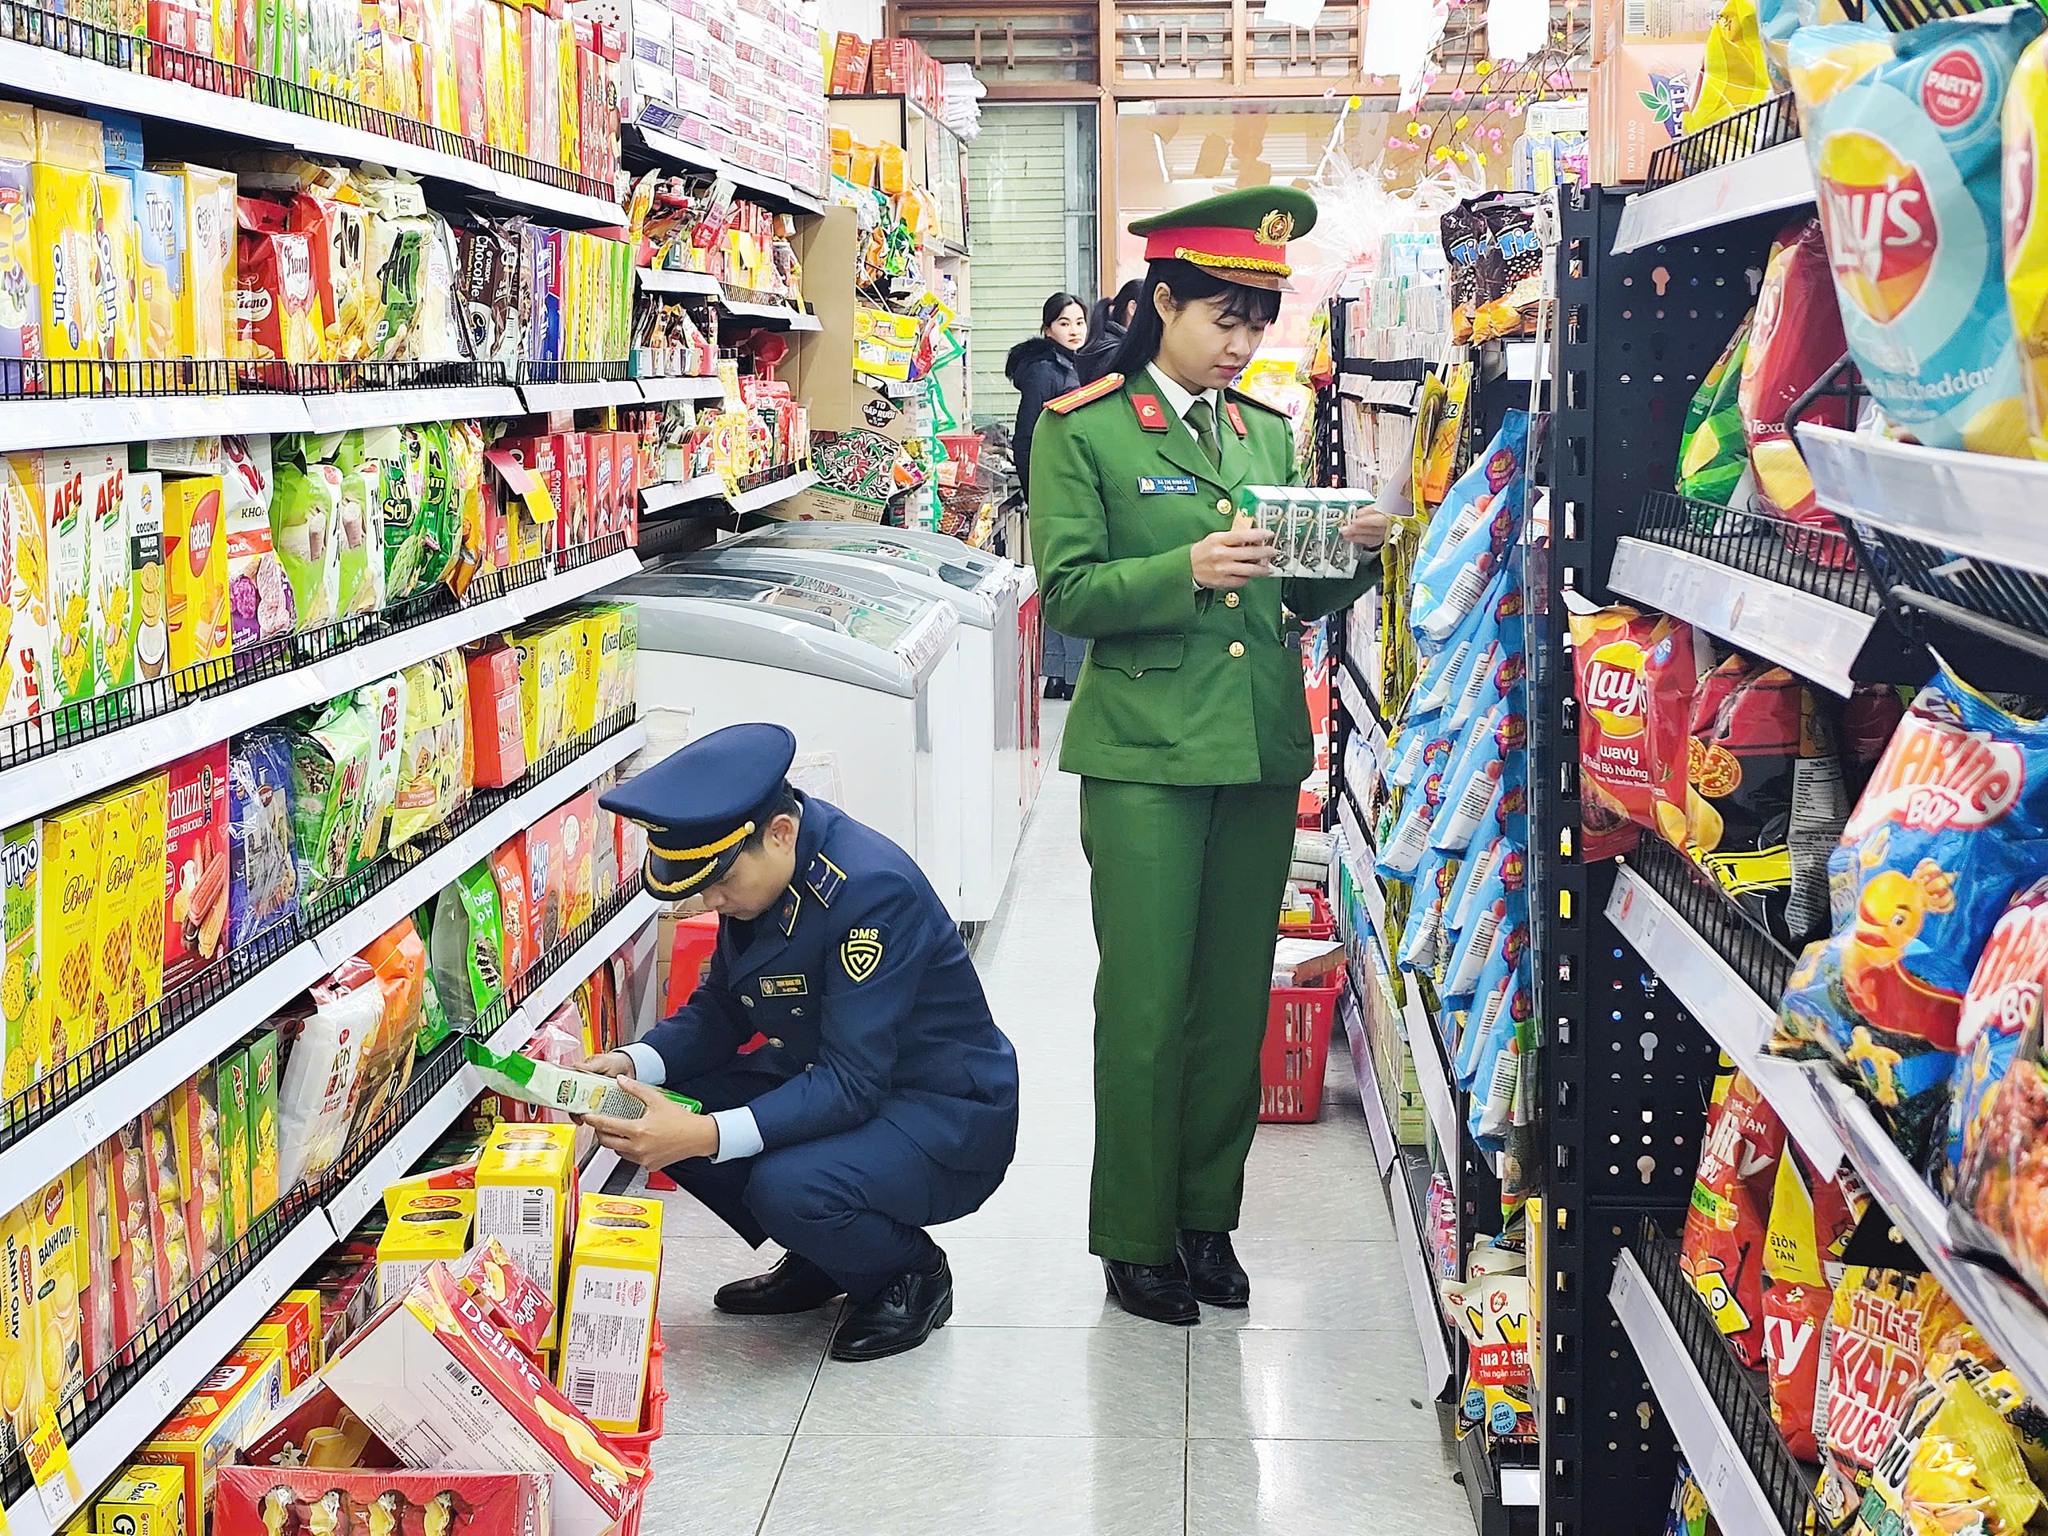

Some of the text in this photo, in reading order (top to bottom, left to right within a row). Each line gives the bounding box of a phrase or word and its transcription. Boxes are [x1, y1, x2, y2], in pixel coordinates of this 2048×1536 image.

[1926, 70, 1982, 98] PARTY
[146, 192, 174, 246] Tipo
[1752, 419, 1786, 435] Texa
[52, 472, 82, 529] AFC
[95, 468, 123, 523] AFC
[384, 499, 408, 520] Sen
[136, 521, 159, 534] COCONUT
[1600, 745, 1639, 766] wavy
[1906, 789, 1960, 829] BOY
[2, 839, 38, 890] Tipo
[106, 855, 136, 893] Belgi
[62, 874, 95, 914] Belgi
[849, 928, 880, 940] DMS
[39, 1237, 59, 1267] BÁNH
[1770, 1235, 1797, 1250] GIÒN
[1774, 1249, 1796, 1262] TAN
[7, 1233, 20, 1340] BÁNH QUY
[459, 1297, 543, 1391] DeliPie
[1501, 1352, 1509, 1366] 2
